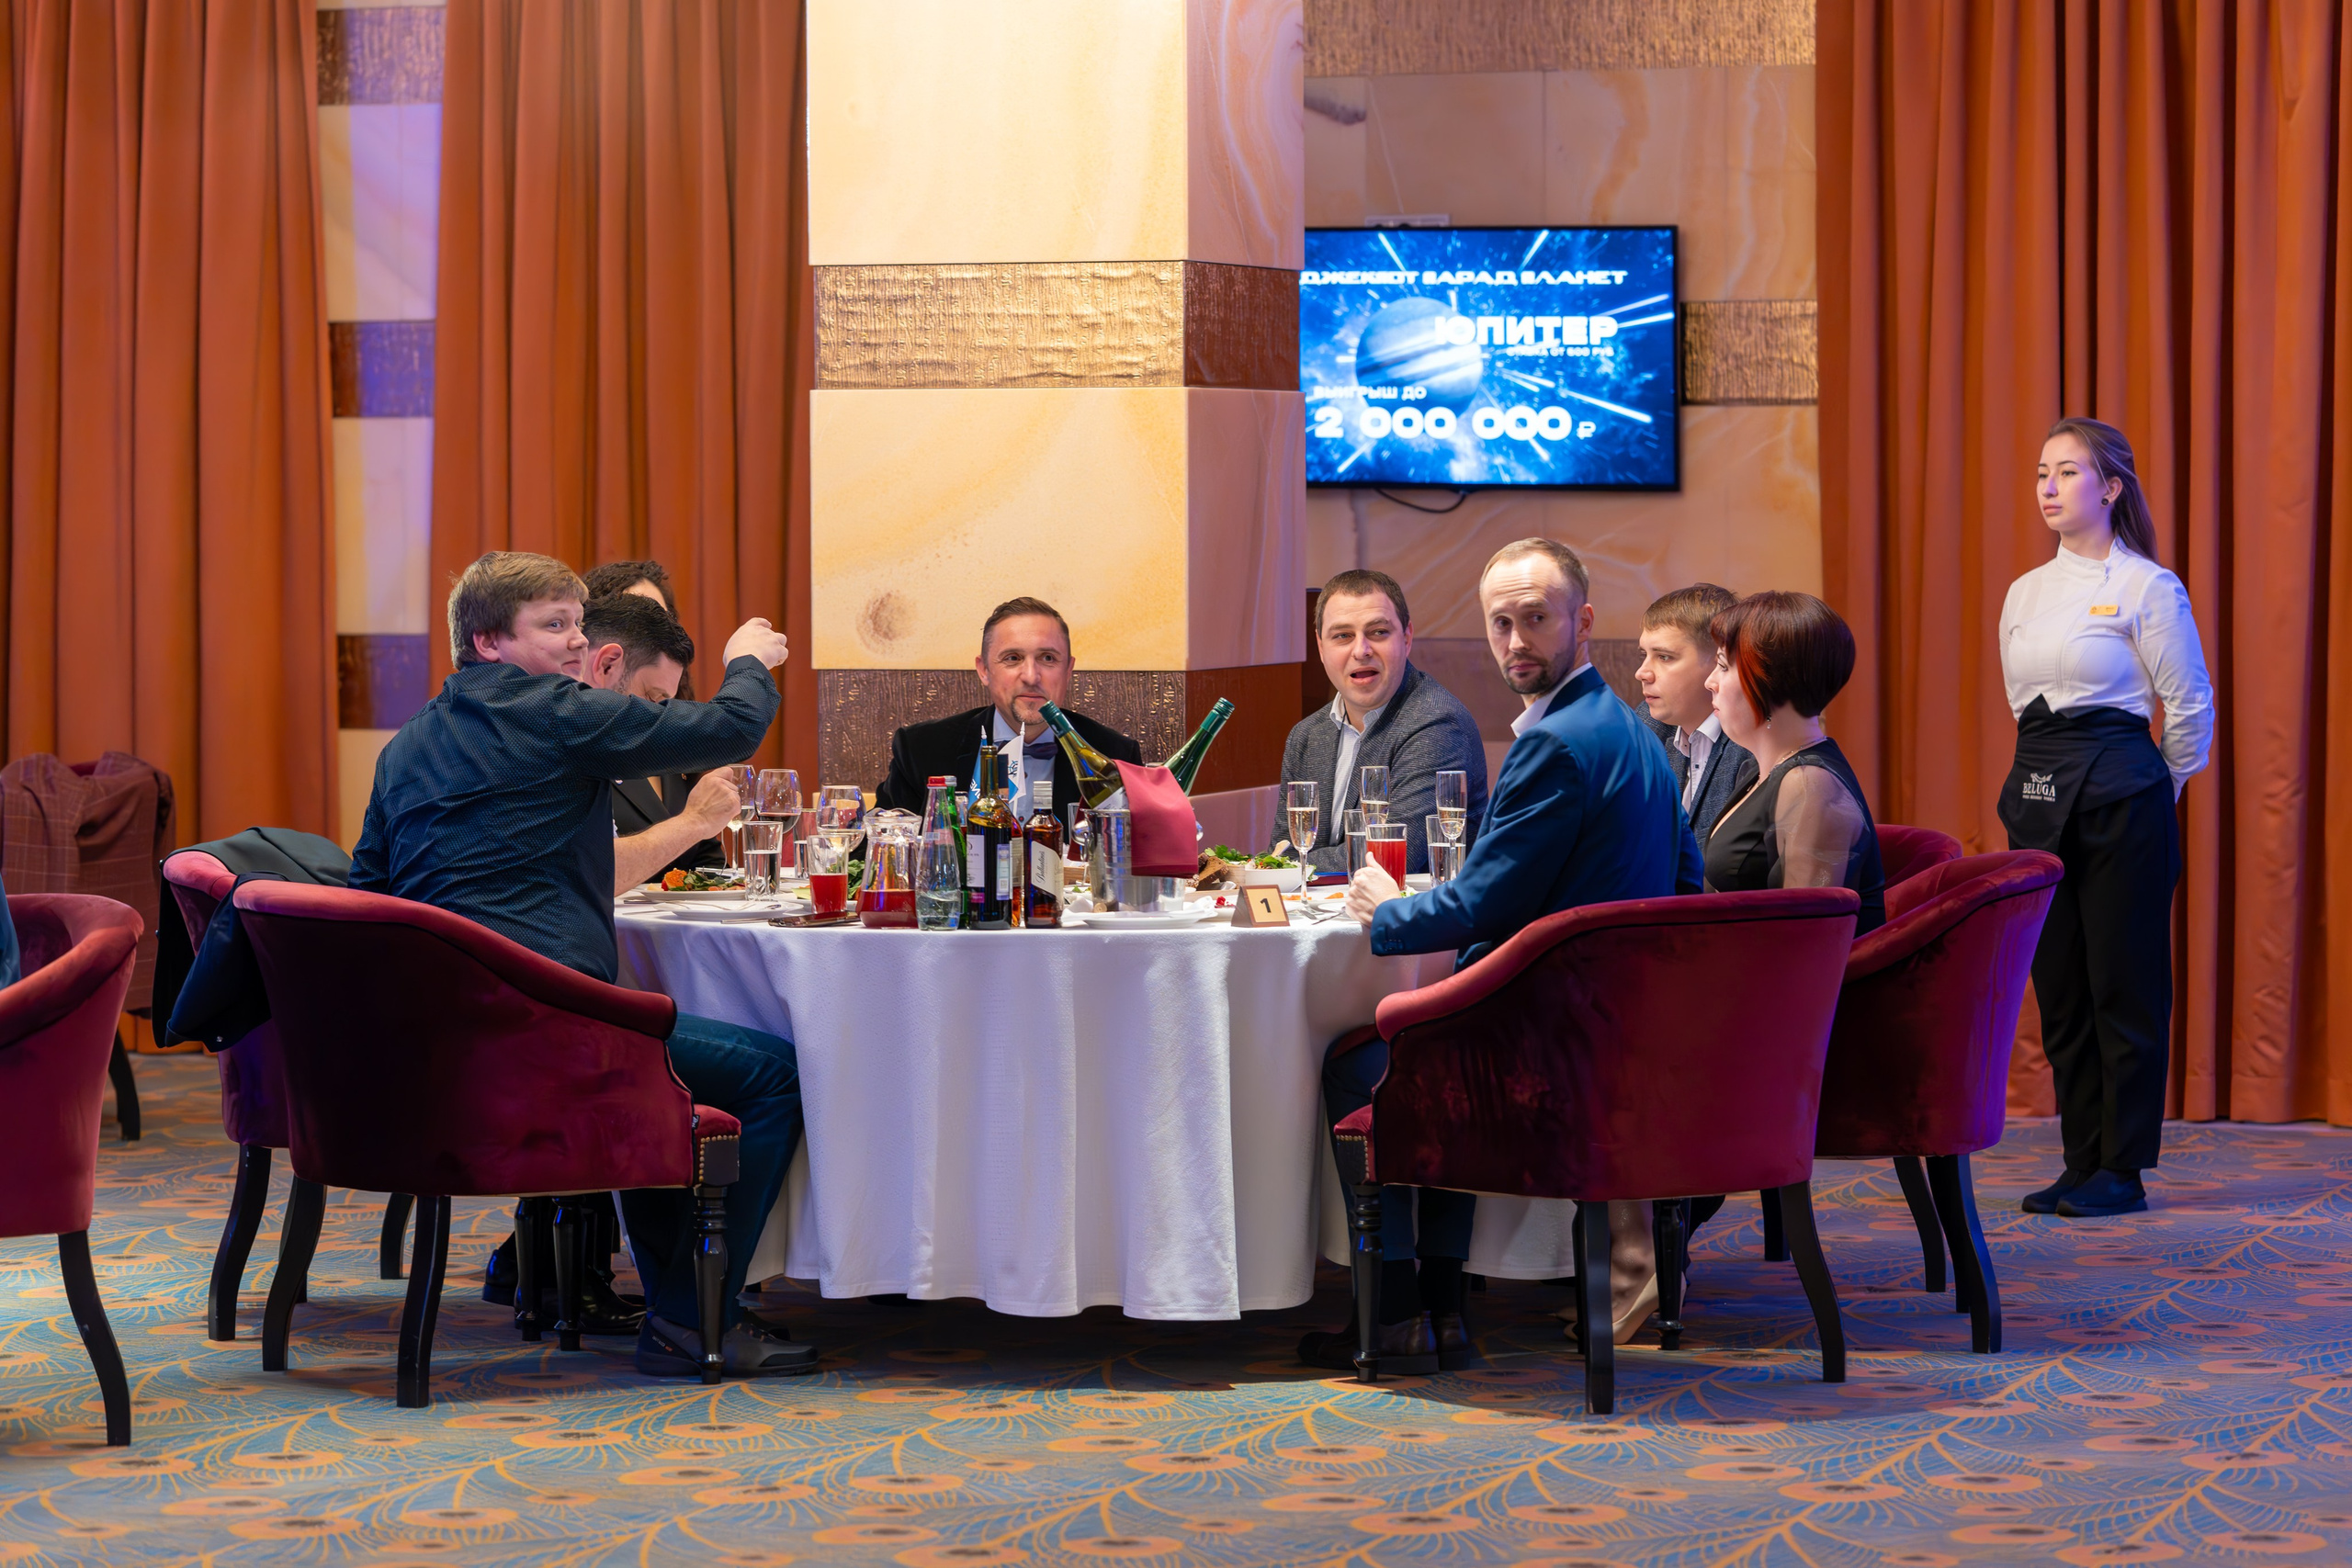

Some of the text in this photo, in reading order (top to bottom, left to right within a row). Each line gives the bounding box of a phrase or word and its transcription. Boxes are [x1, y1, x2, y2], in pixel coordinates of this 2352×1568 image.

[1434, 315, 1618, 345] ЮПИТЕР
[1312, 386, 1427, 400] ВЫИГРЫШ ДО
[1314, 406, 1344, 438] 2
[1359, 406, 1457, 439] 000
[1471, 405, 1573, 441] 000
[2022, 783, 2056, 797] BELUGA
[1260, 897, 1272, 913] 1
